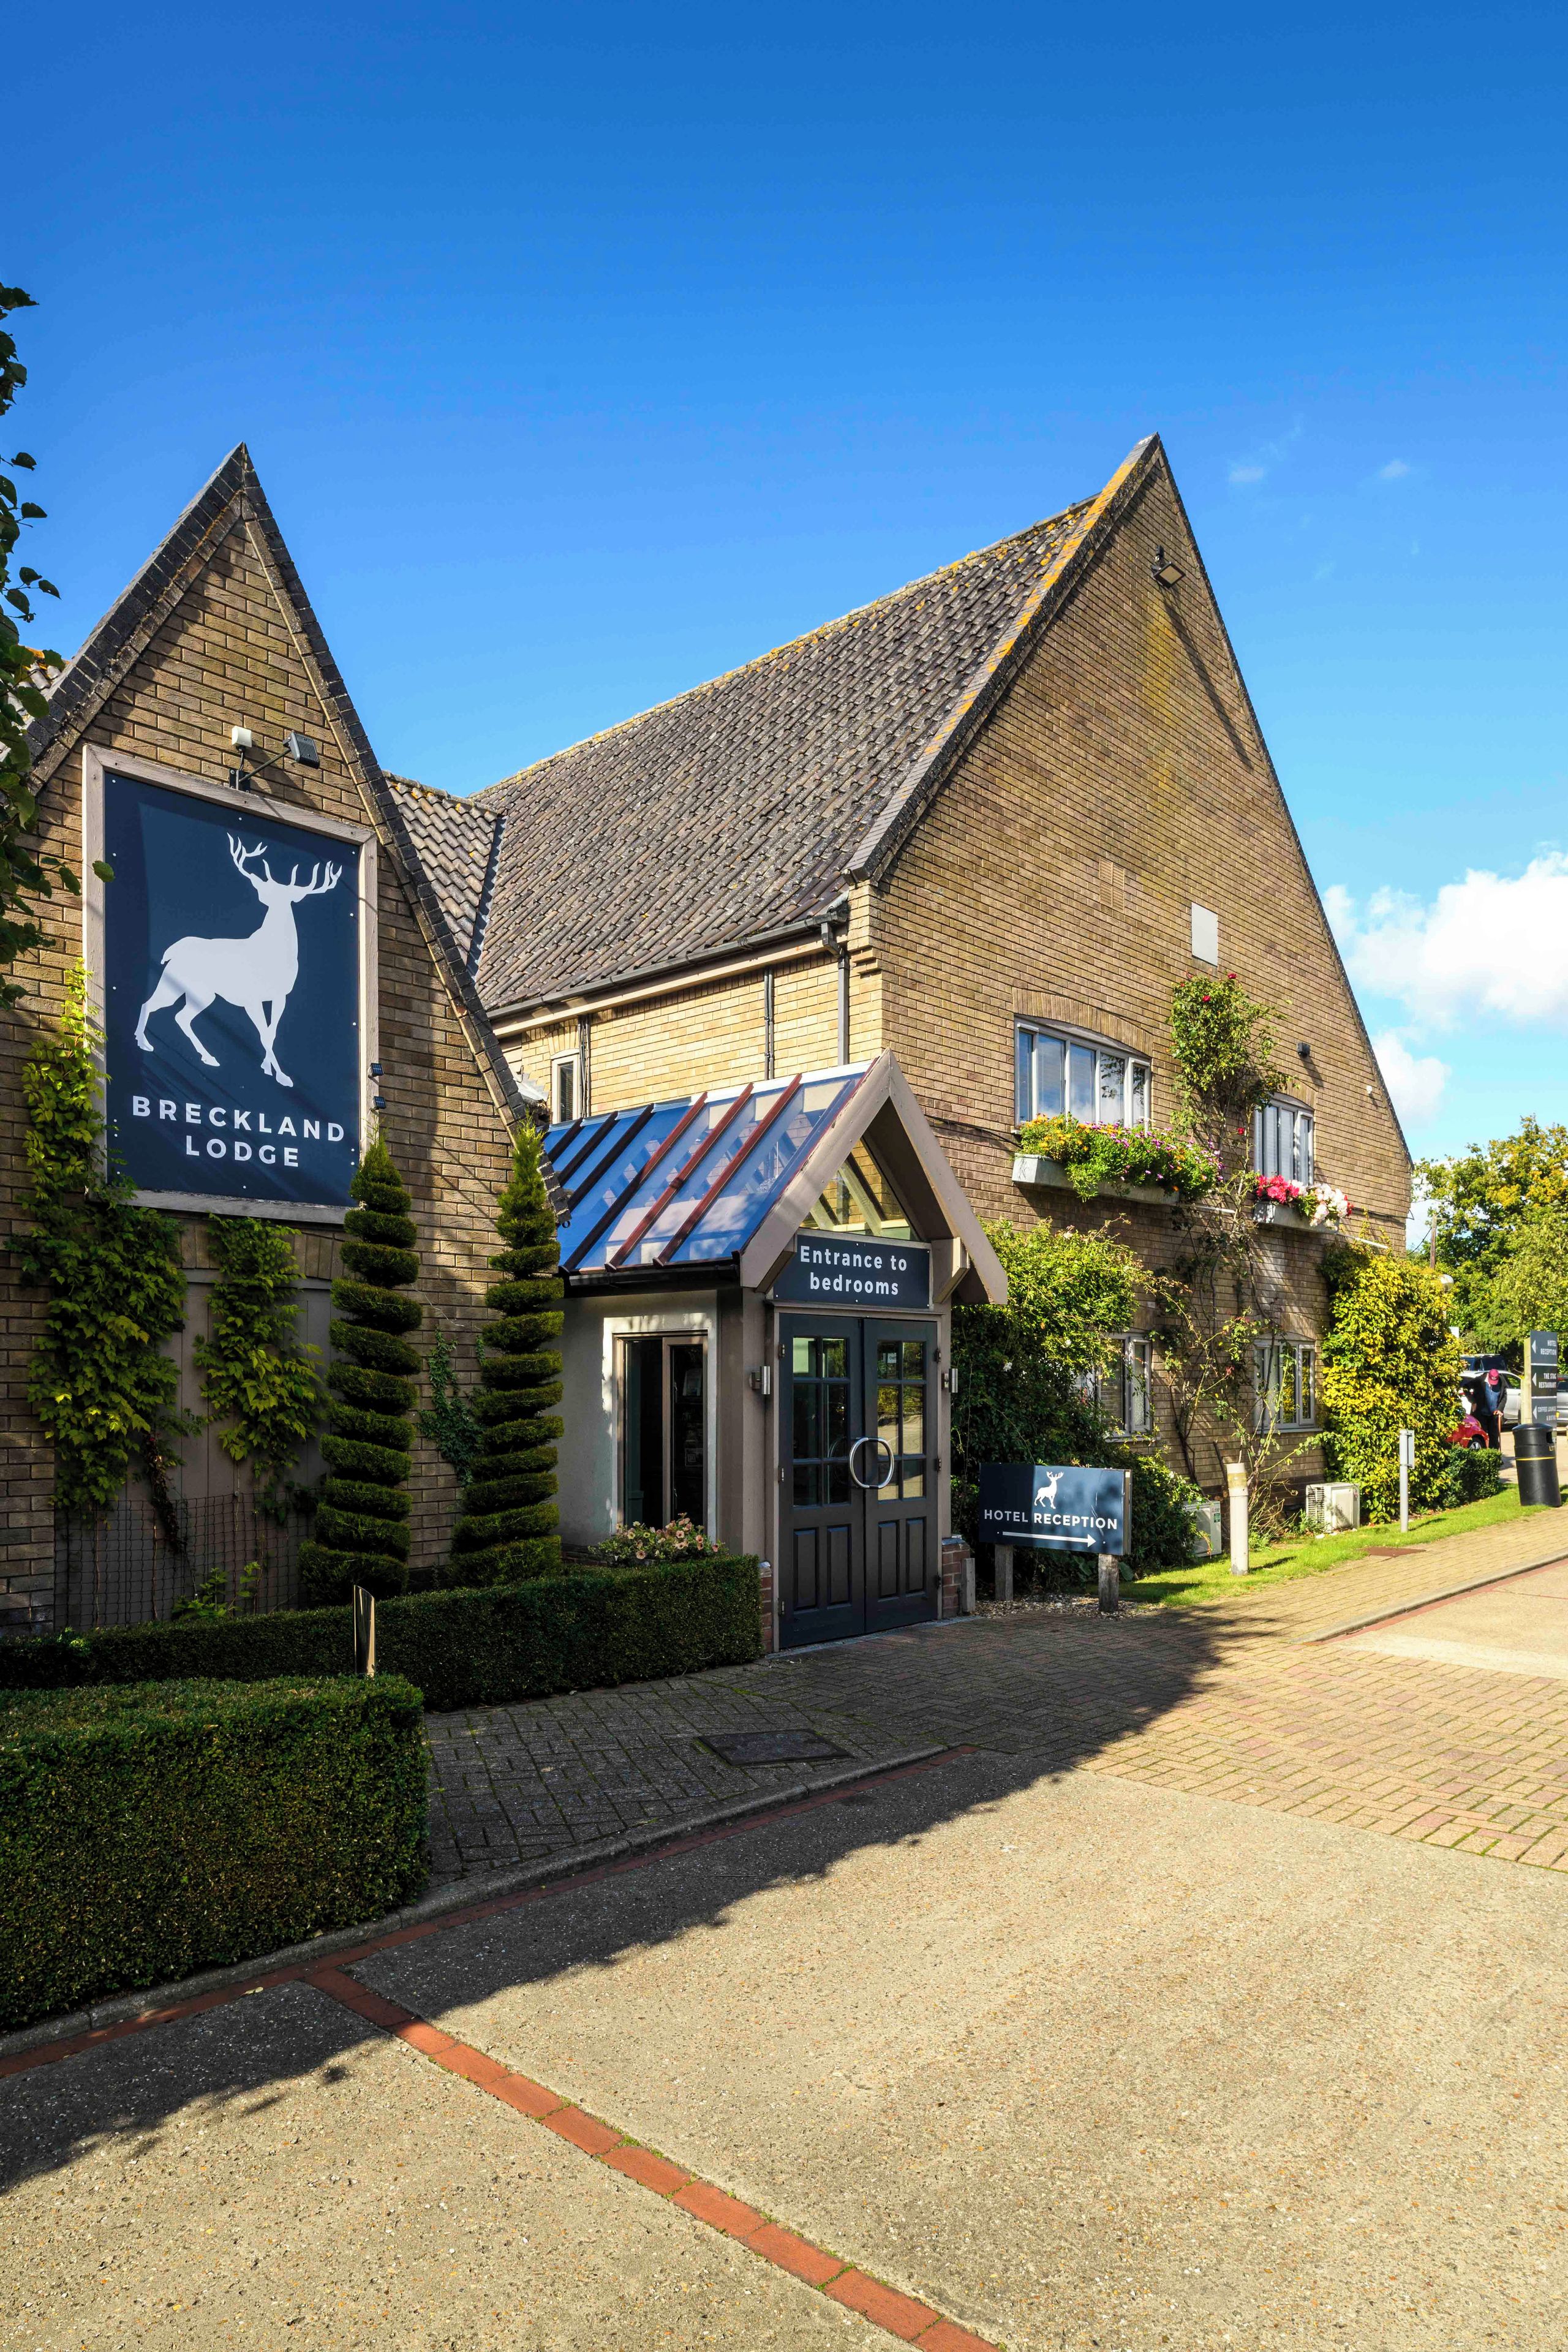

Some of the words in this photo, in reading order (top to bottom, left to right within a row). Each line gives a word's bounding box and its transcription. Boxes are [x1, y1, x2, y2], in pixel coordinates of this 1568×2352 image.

[133, 1095, 344, 1142] BRECKLAND
[186, 1135, 298, 1167] LODGE
[801, 1245, 883, 1269] Entrance
[891, 1255, 907, 1271] to
[810, 1272, 899, 1295] bedrooms
[984, 1509, 1028, 1523] HOTEL
[1033, 1512, 1118, 1530] RECEPTION
